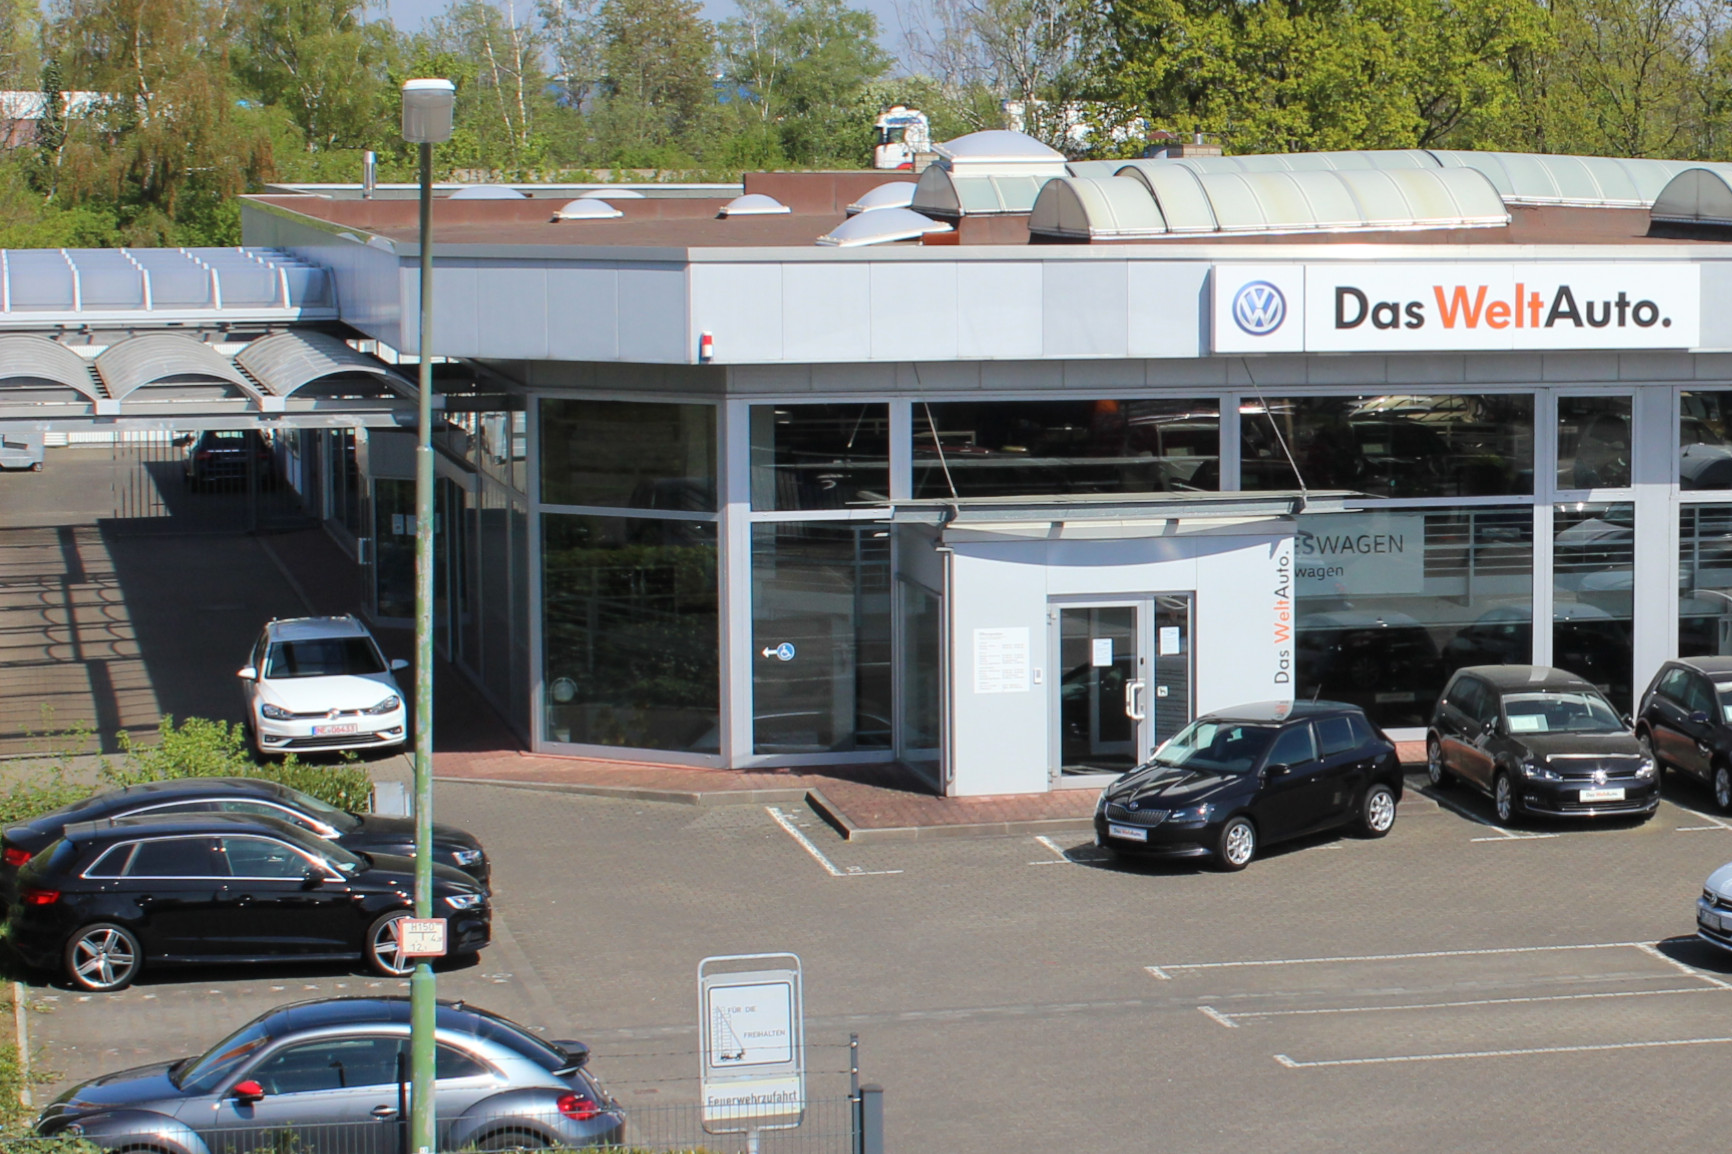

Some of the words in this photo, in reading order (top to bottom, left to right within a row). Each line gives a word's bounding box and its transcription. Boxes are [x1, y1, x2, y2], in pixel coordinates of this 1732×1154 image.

[1334, 286, 1425, 330] Das
[1433, 282, 1672, 330] WeltAuto.
[1295, 565, 1344, 581] wagen
[1273, 550, 1291, 644] WeltAuto.
[1274, 649, 1290, 684] Das
[743, 1029, 786, 1039] FREIHALTEN
[707, 1090, 798, 1107] Feuerwehrzufahrt
